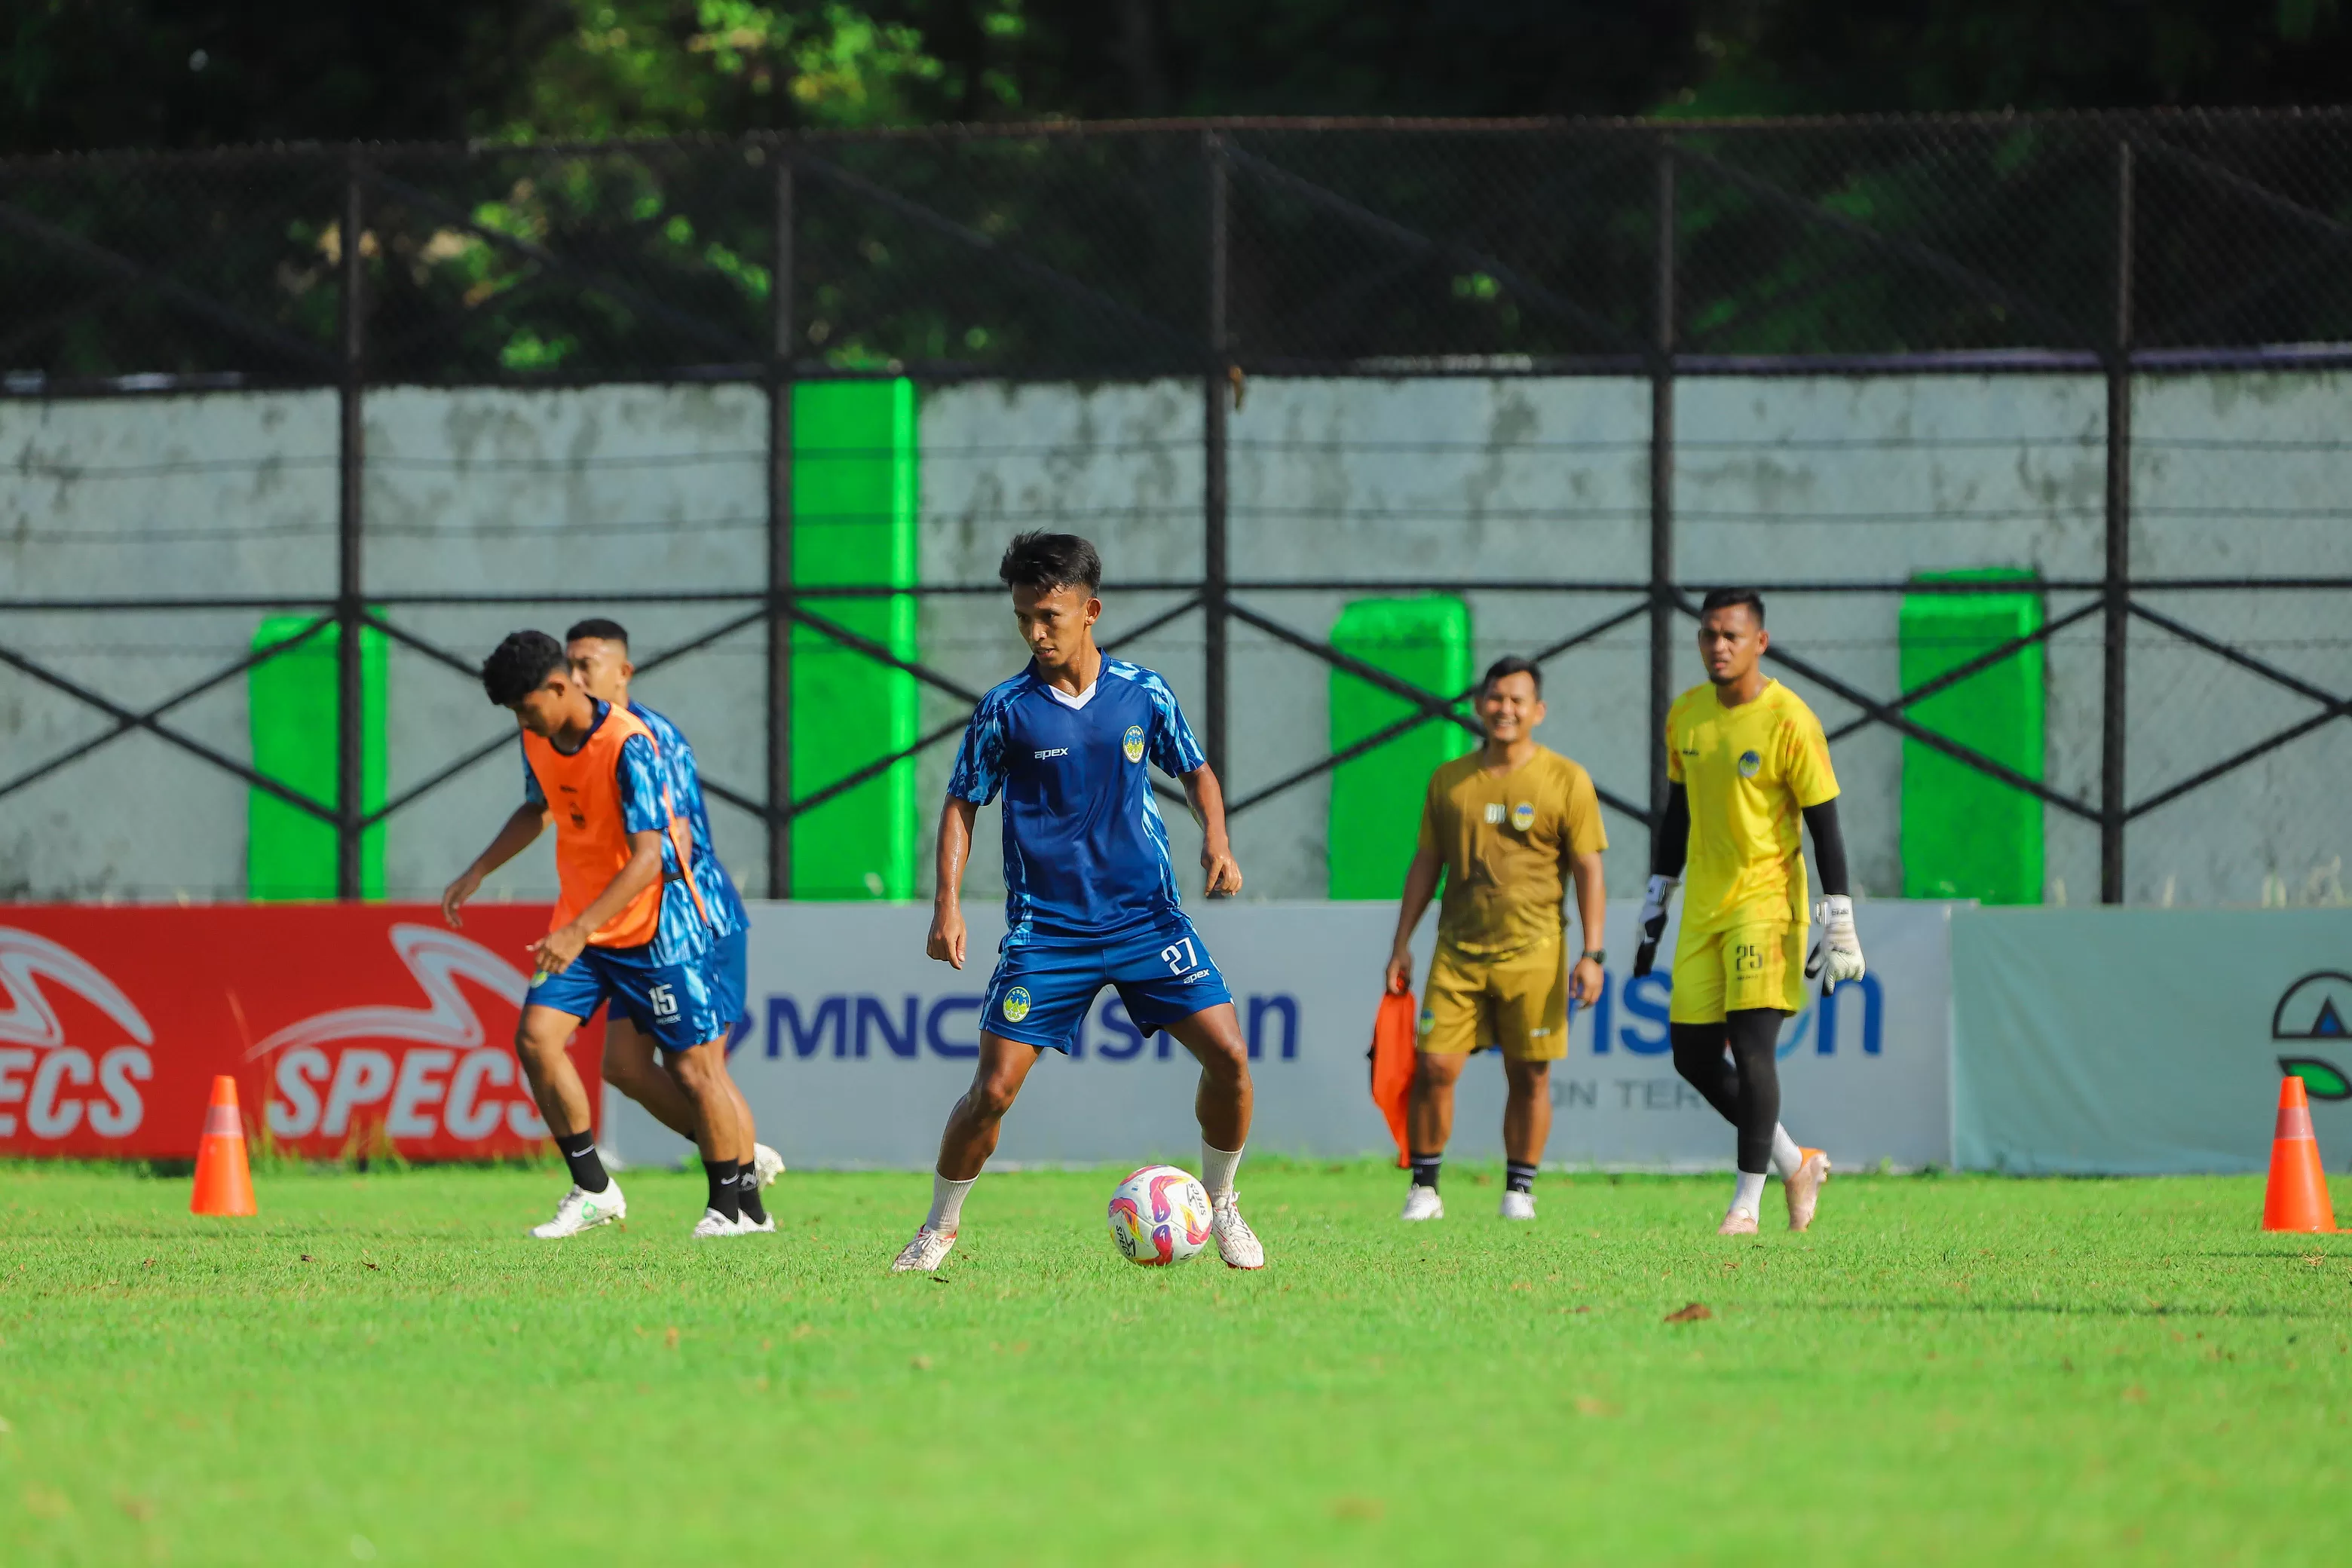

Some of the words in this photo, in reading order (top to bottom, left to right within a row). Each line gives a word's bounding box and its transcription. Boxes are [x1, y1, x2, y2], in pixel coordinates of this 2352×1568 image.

[1034, 747, 1069, 761] apex
[1161, 936, 1198, 975] 27
[1736, 944, 1763, 972] 25
[1183, 969, 1210, 984] apex
[648, 983, 678, 1016] 15
[764, 994, 982, 1060] MNC
[1188, 1182, 1207, 1217] SPECS
